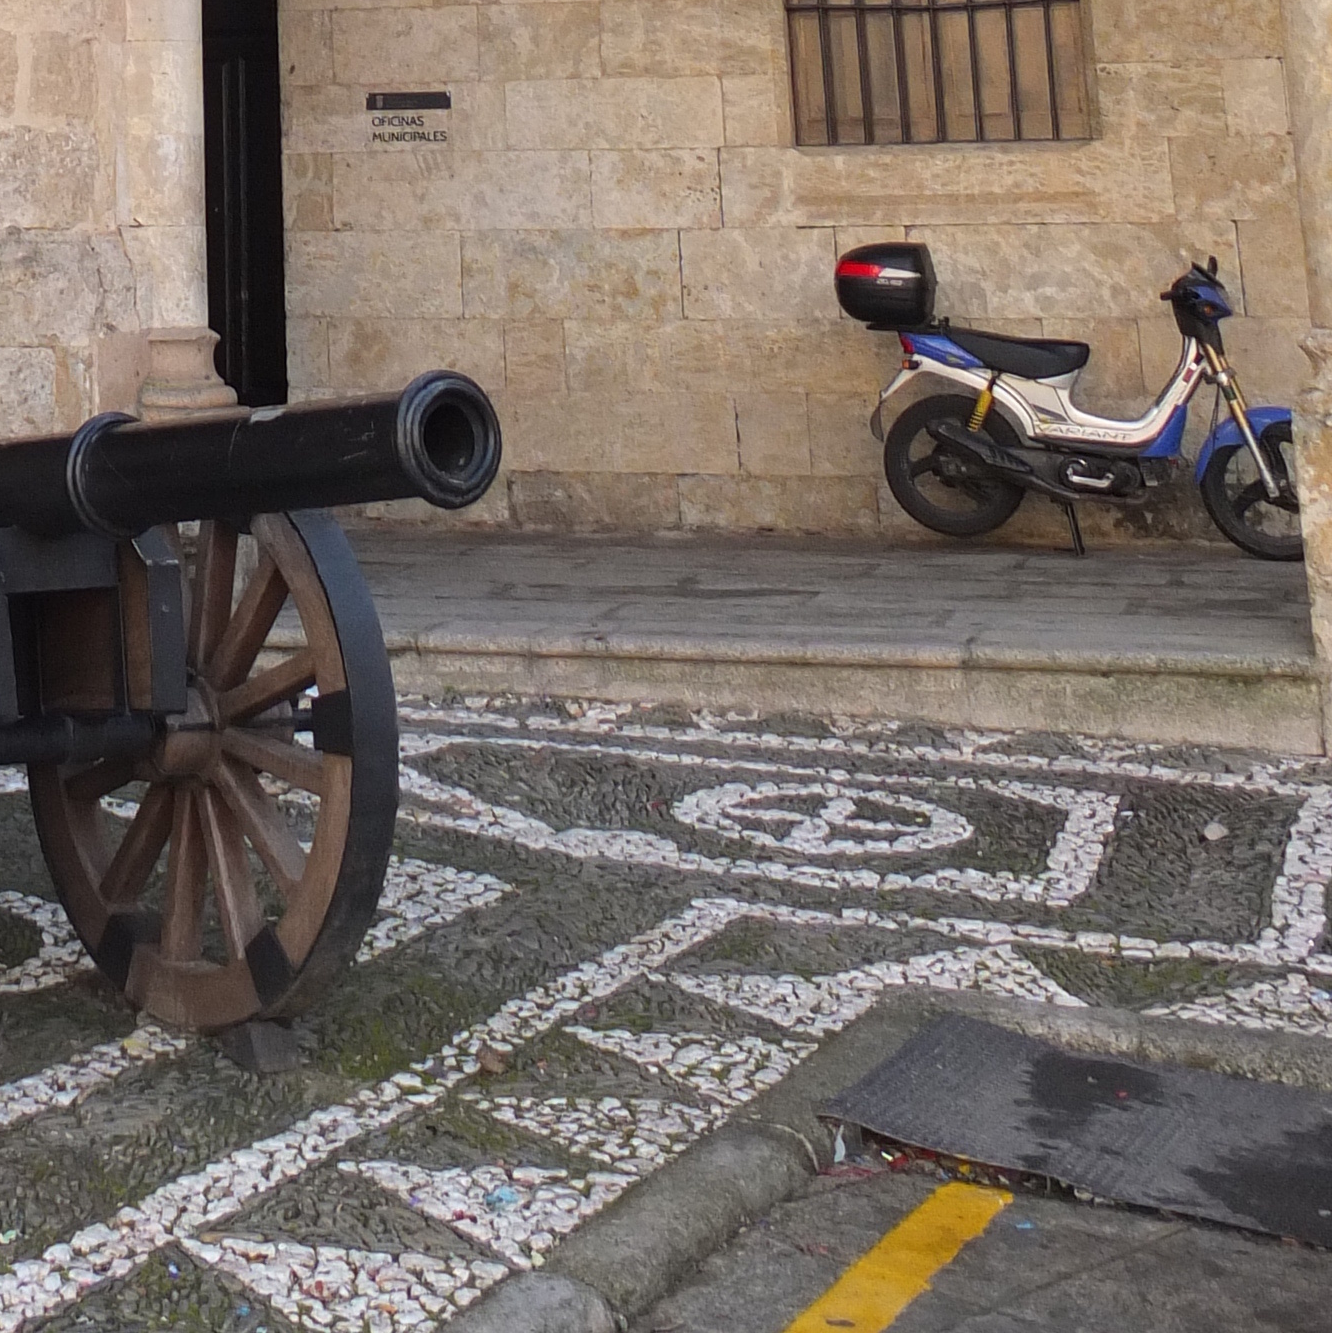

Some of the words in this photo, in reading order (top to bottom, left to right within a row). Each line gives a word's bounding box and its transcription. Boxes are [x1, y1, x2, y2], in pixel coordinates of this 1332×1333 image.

[371, 115, 425, 128] OFICINAS
[372, 130, 448, 143] MUNICIPALES
[1034, 423, 1133, 442] VARIANT
